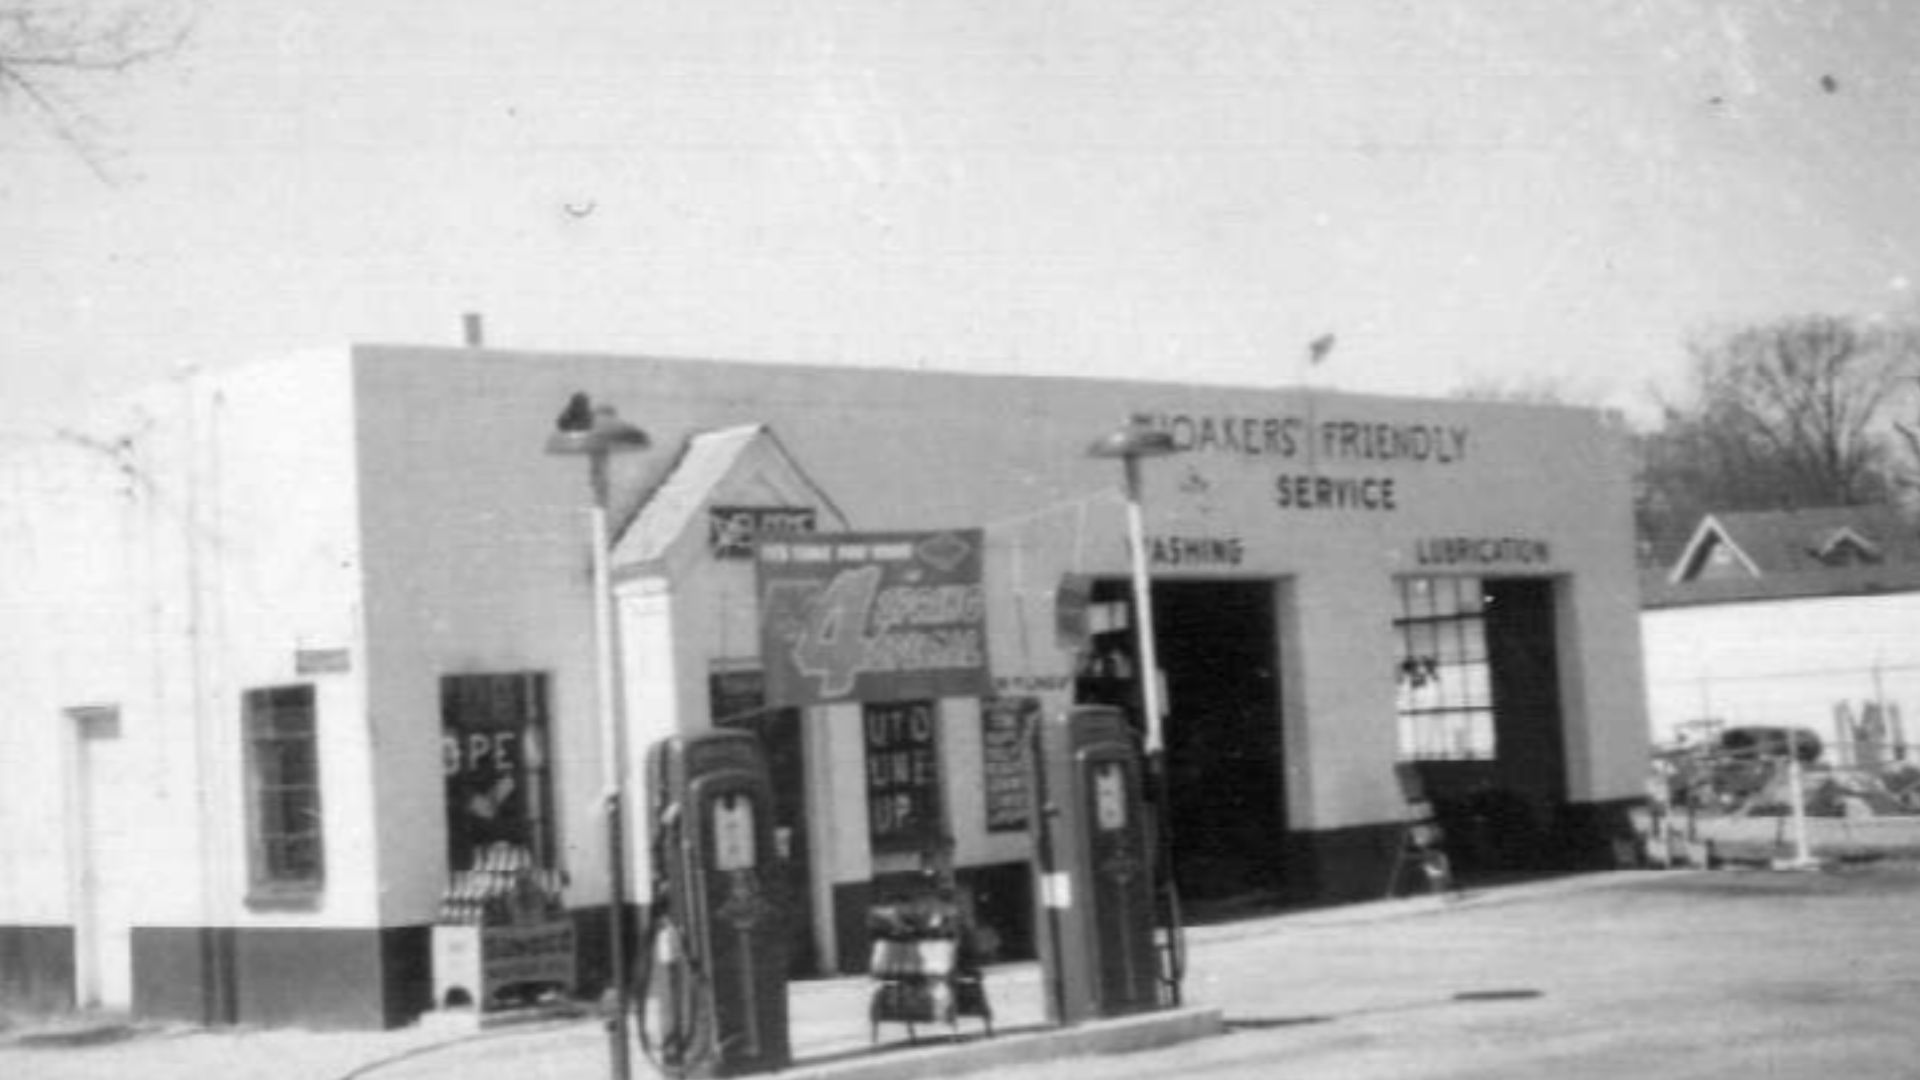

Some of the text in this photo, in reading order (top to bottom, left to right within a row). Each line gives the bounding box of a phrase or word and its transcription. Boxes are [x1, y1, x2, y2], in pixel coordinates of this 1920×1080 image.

[1323, 421, 1469, 464] FRIENDLY
[1277, 474, 1396, 510] SERVICE
[1415, 537, 1550, 565] LUBRICATION
